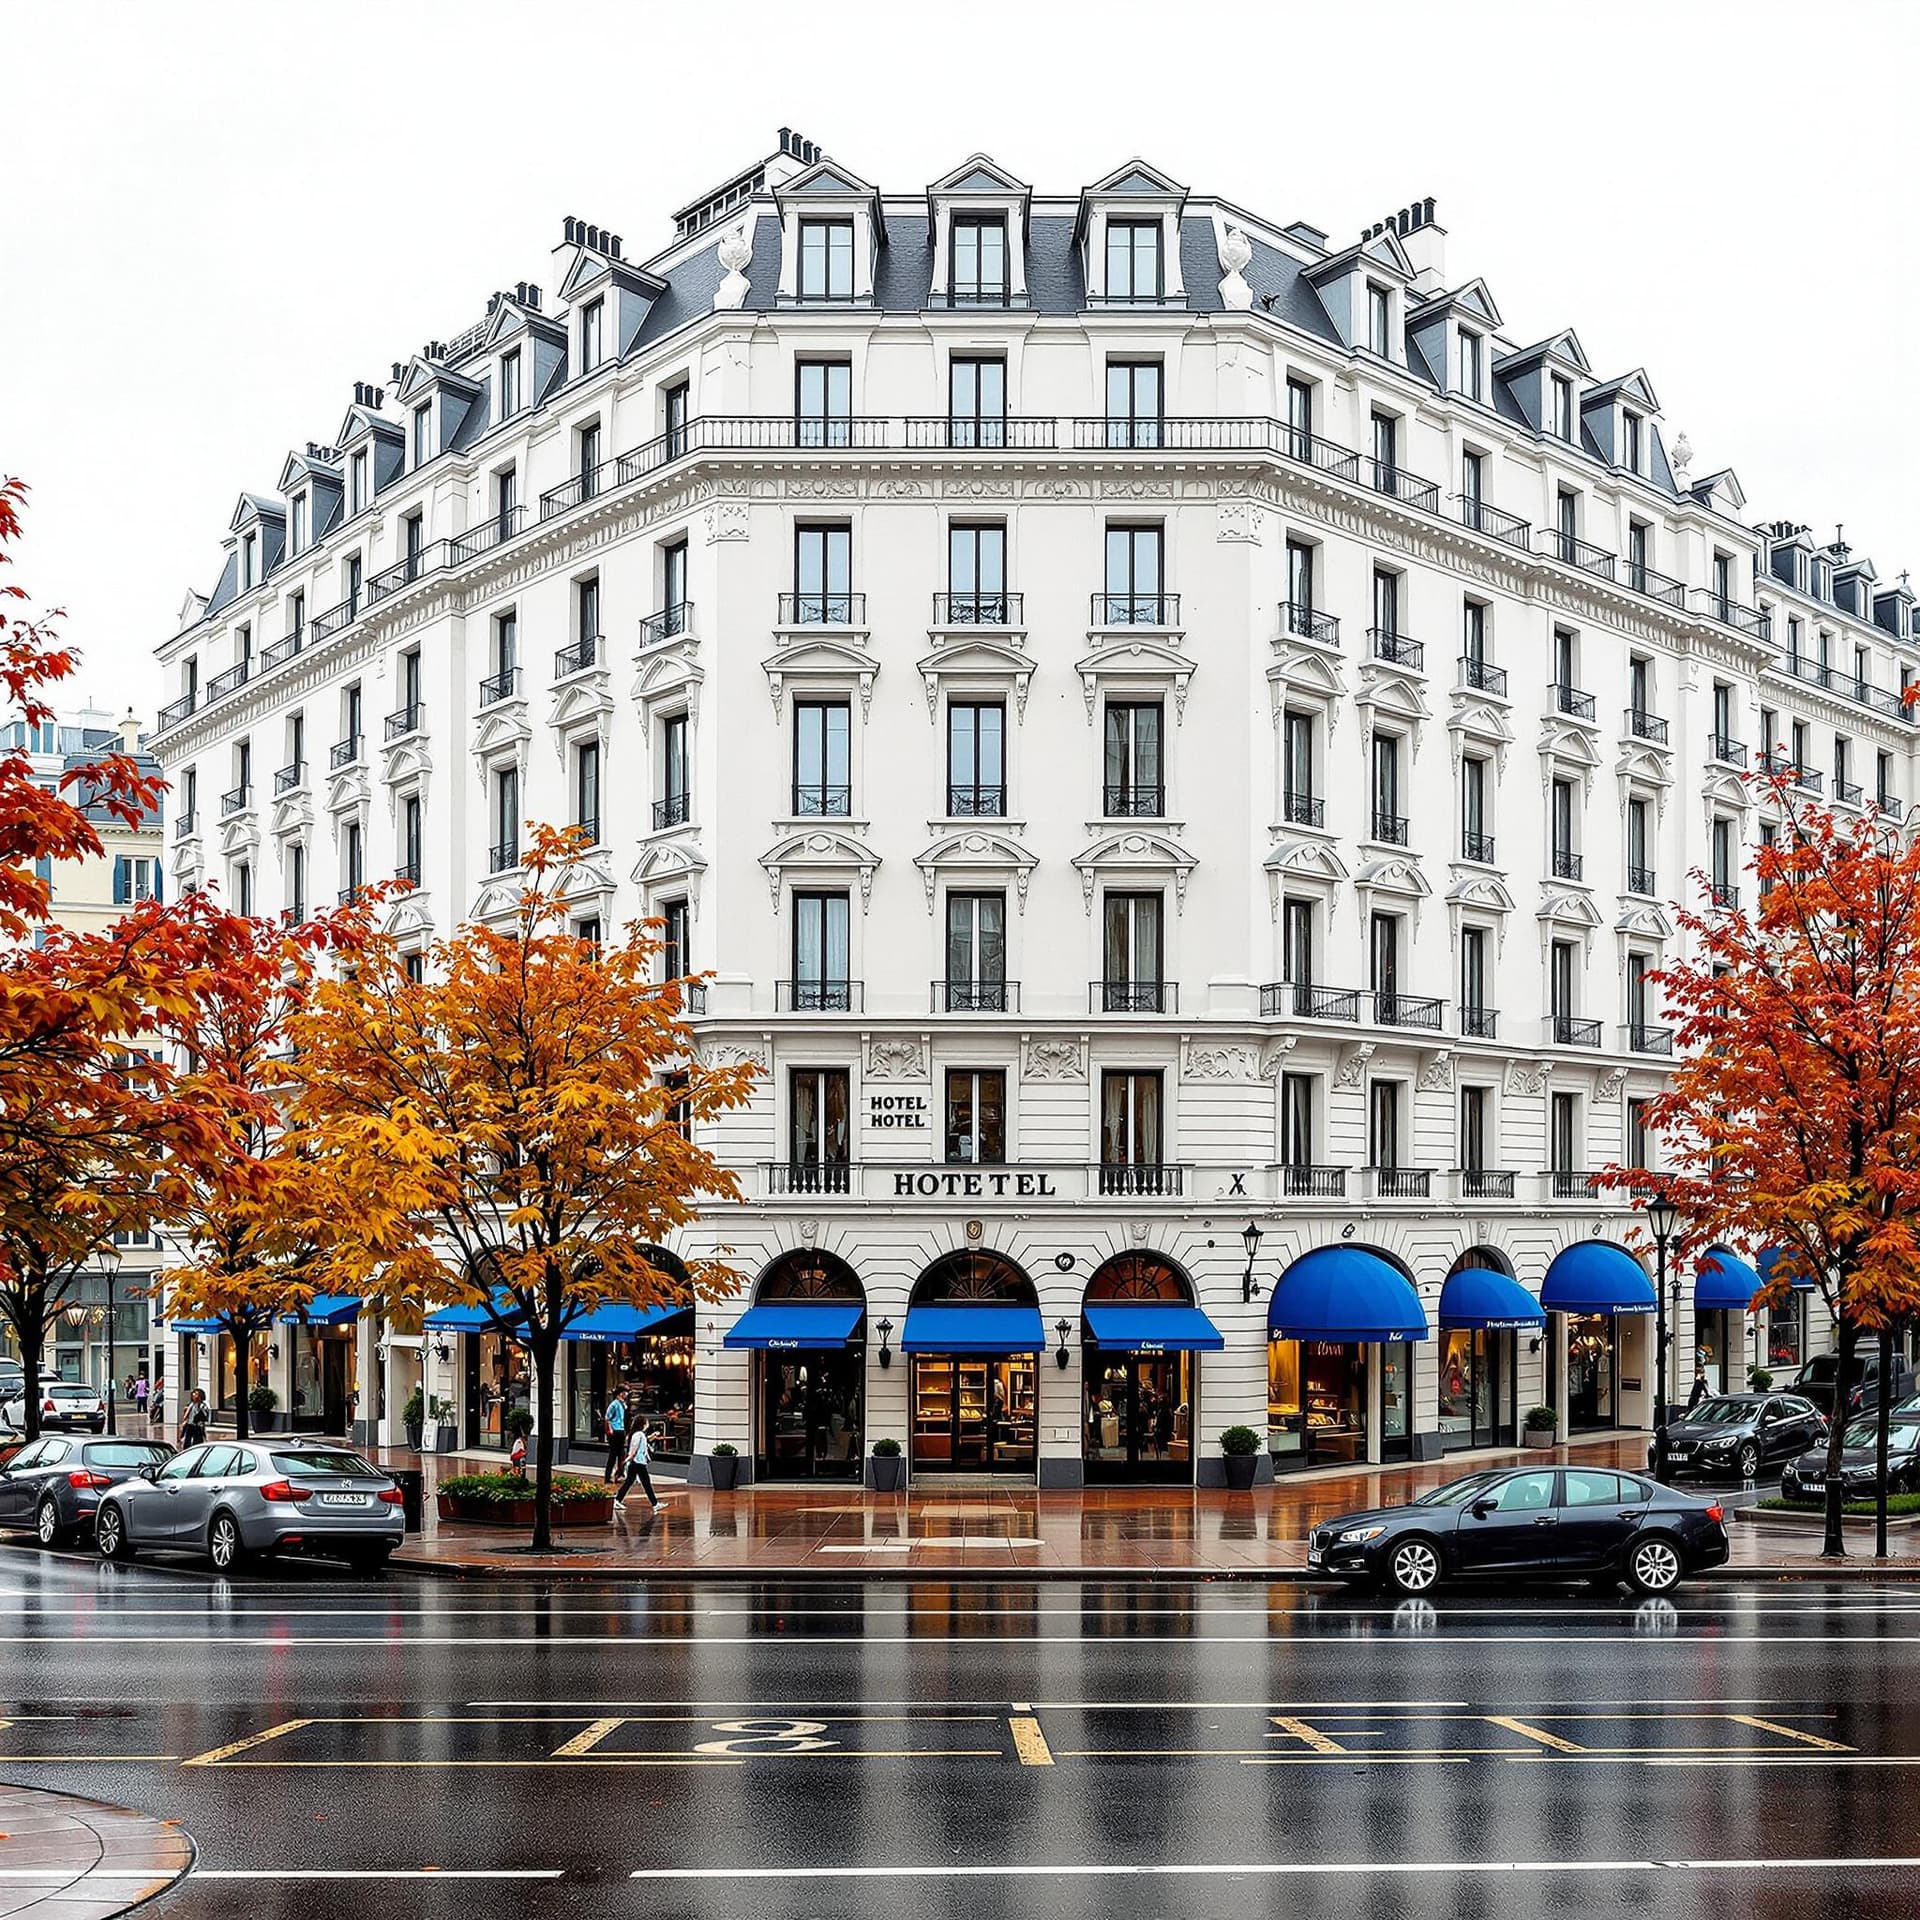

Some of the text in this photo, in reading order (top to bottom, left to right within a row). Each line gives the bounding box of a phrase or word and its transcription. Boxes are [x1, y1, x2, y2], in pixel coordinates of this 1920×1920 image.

[871, 1097, 927, 1110] HOTEL
[871, 1114, 925, 1127] HOTEL
[894, 1173, 1056, 1195] HOTETEL
